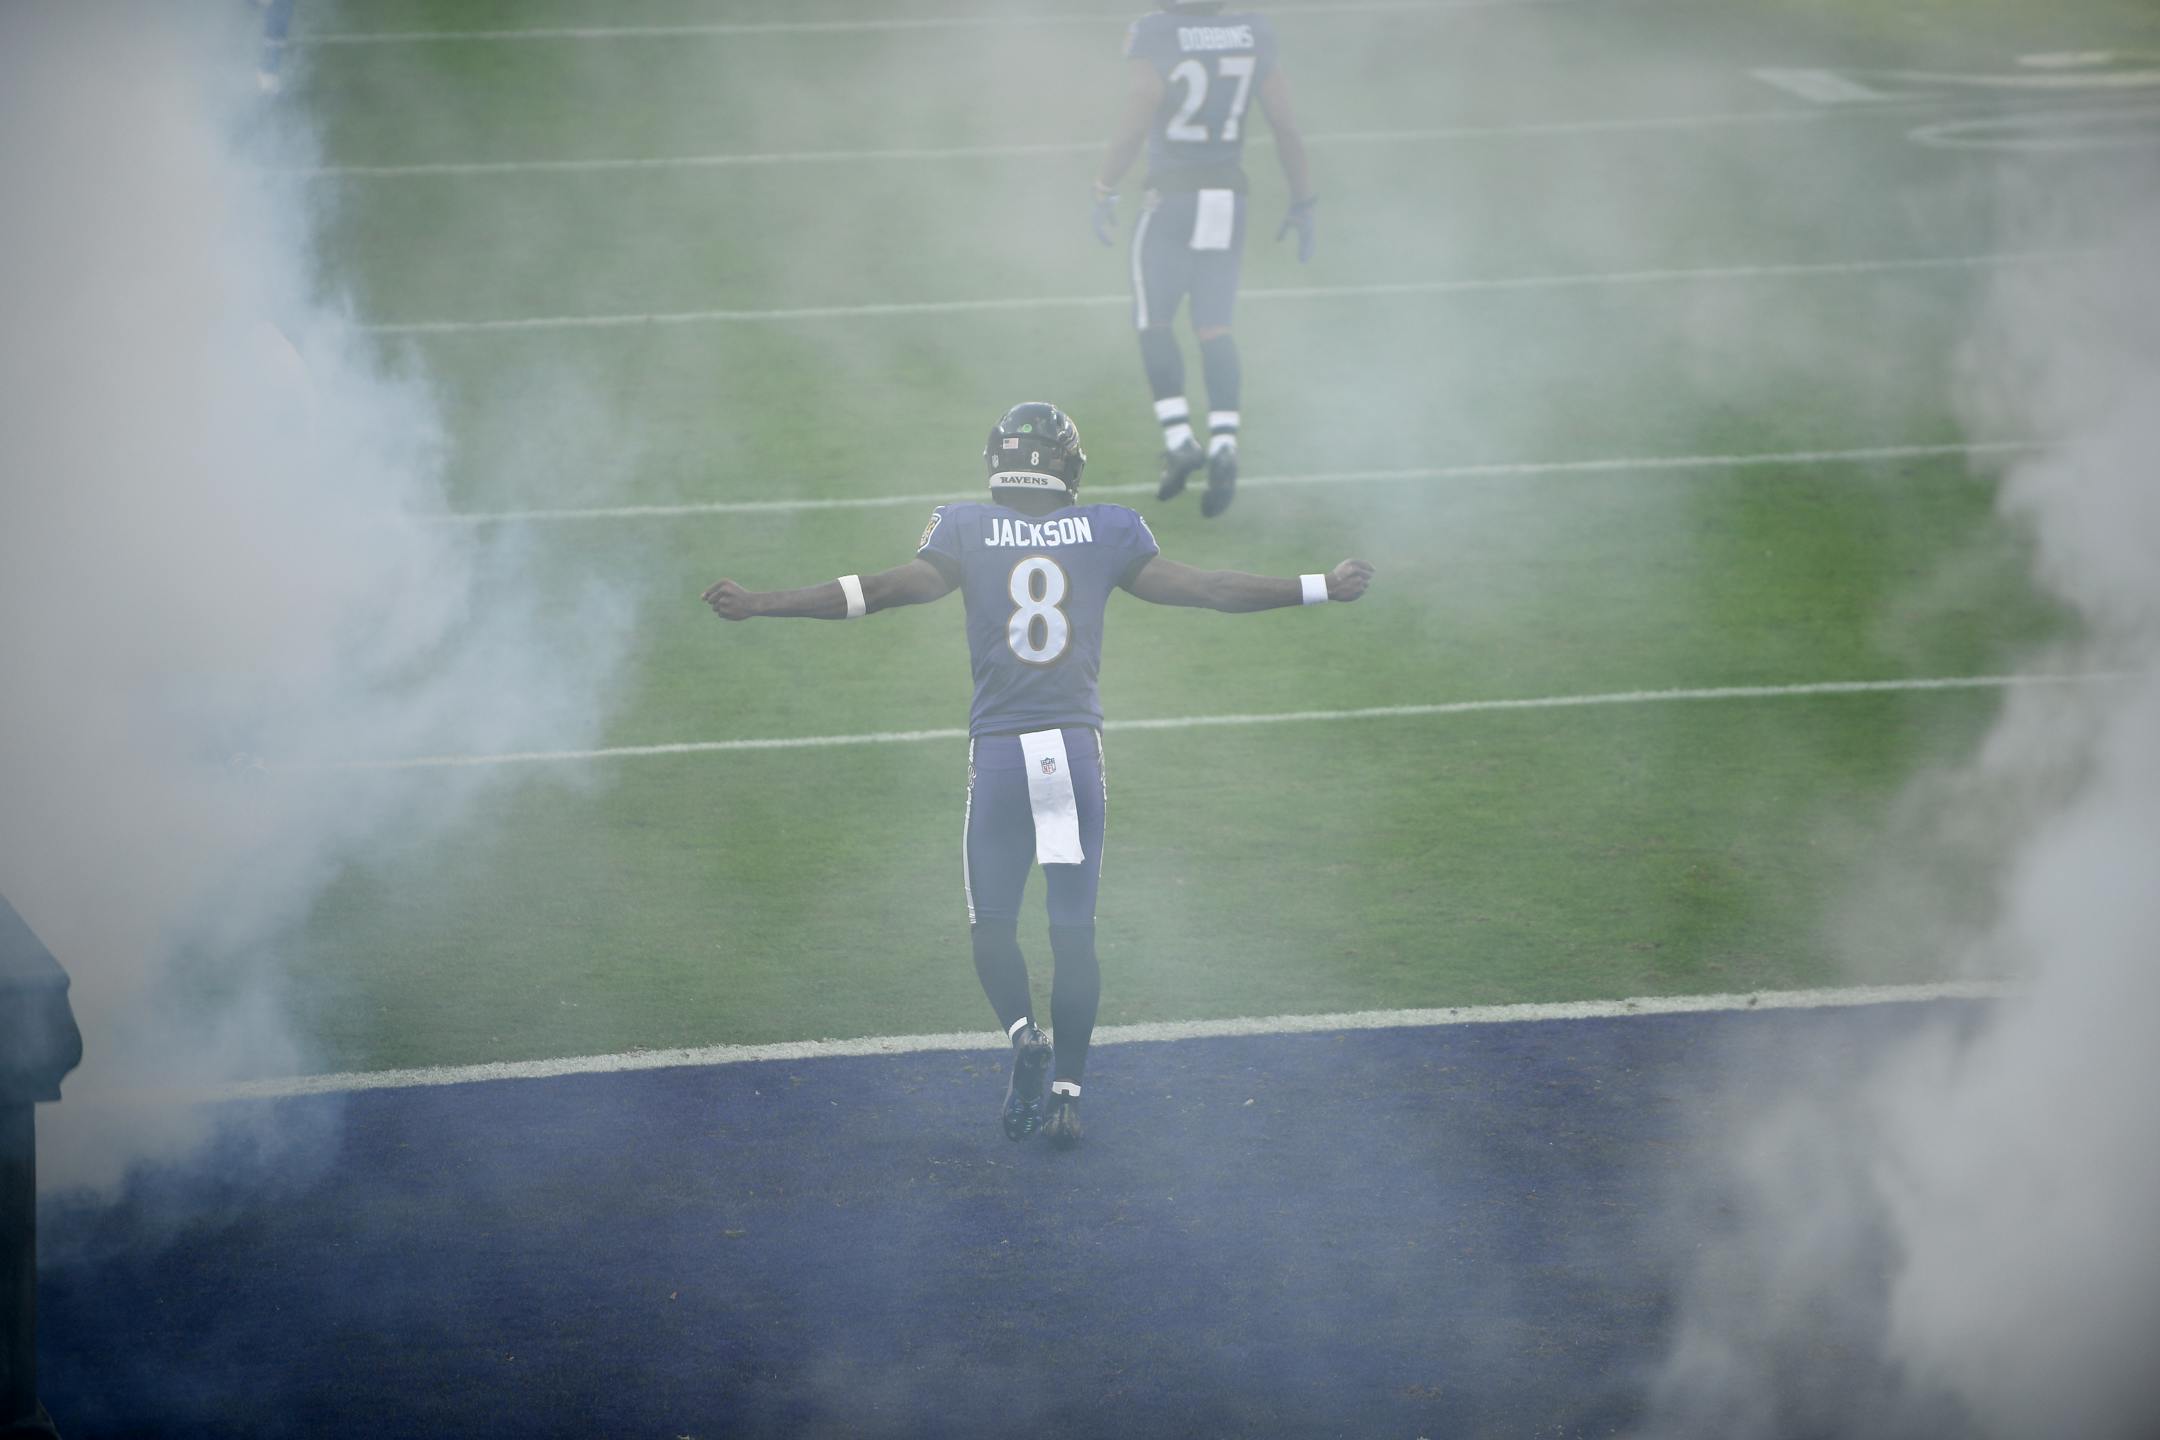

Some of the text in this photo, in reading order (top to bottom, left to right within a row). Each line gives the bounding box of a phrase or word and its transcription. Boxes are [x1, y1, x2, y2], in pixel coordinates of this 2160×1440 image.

[1166, 56, 1256, 141] 27
[1031, 451, 1039, 465] 8
[1000, 476, 1048, 486] RAVENS
[985, 517, 1093, 547] JACKSON
[1007, 556, 1070, 665] 8
